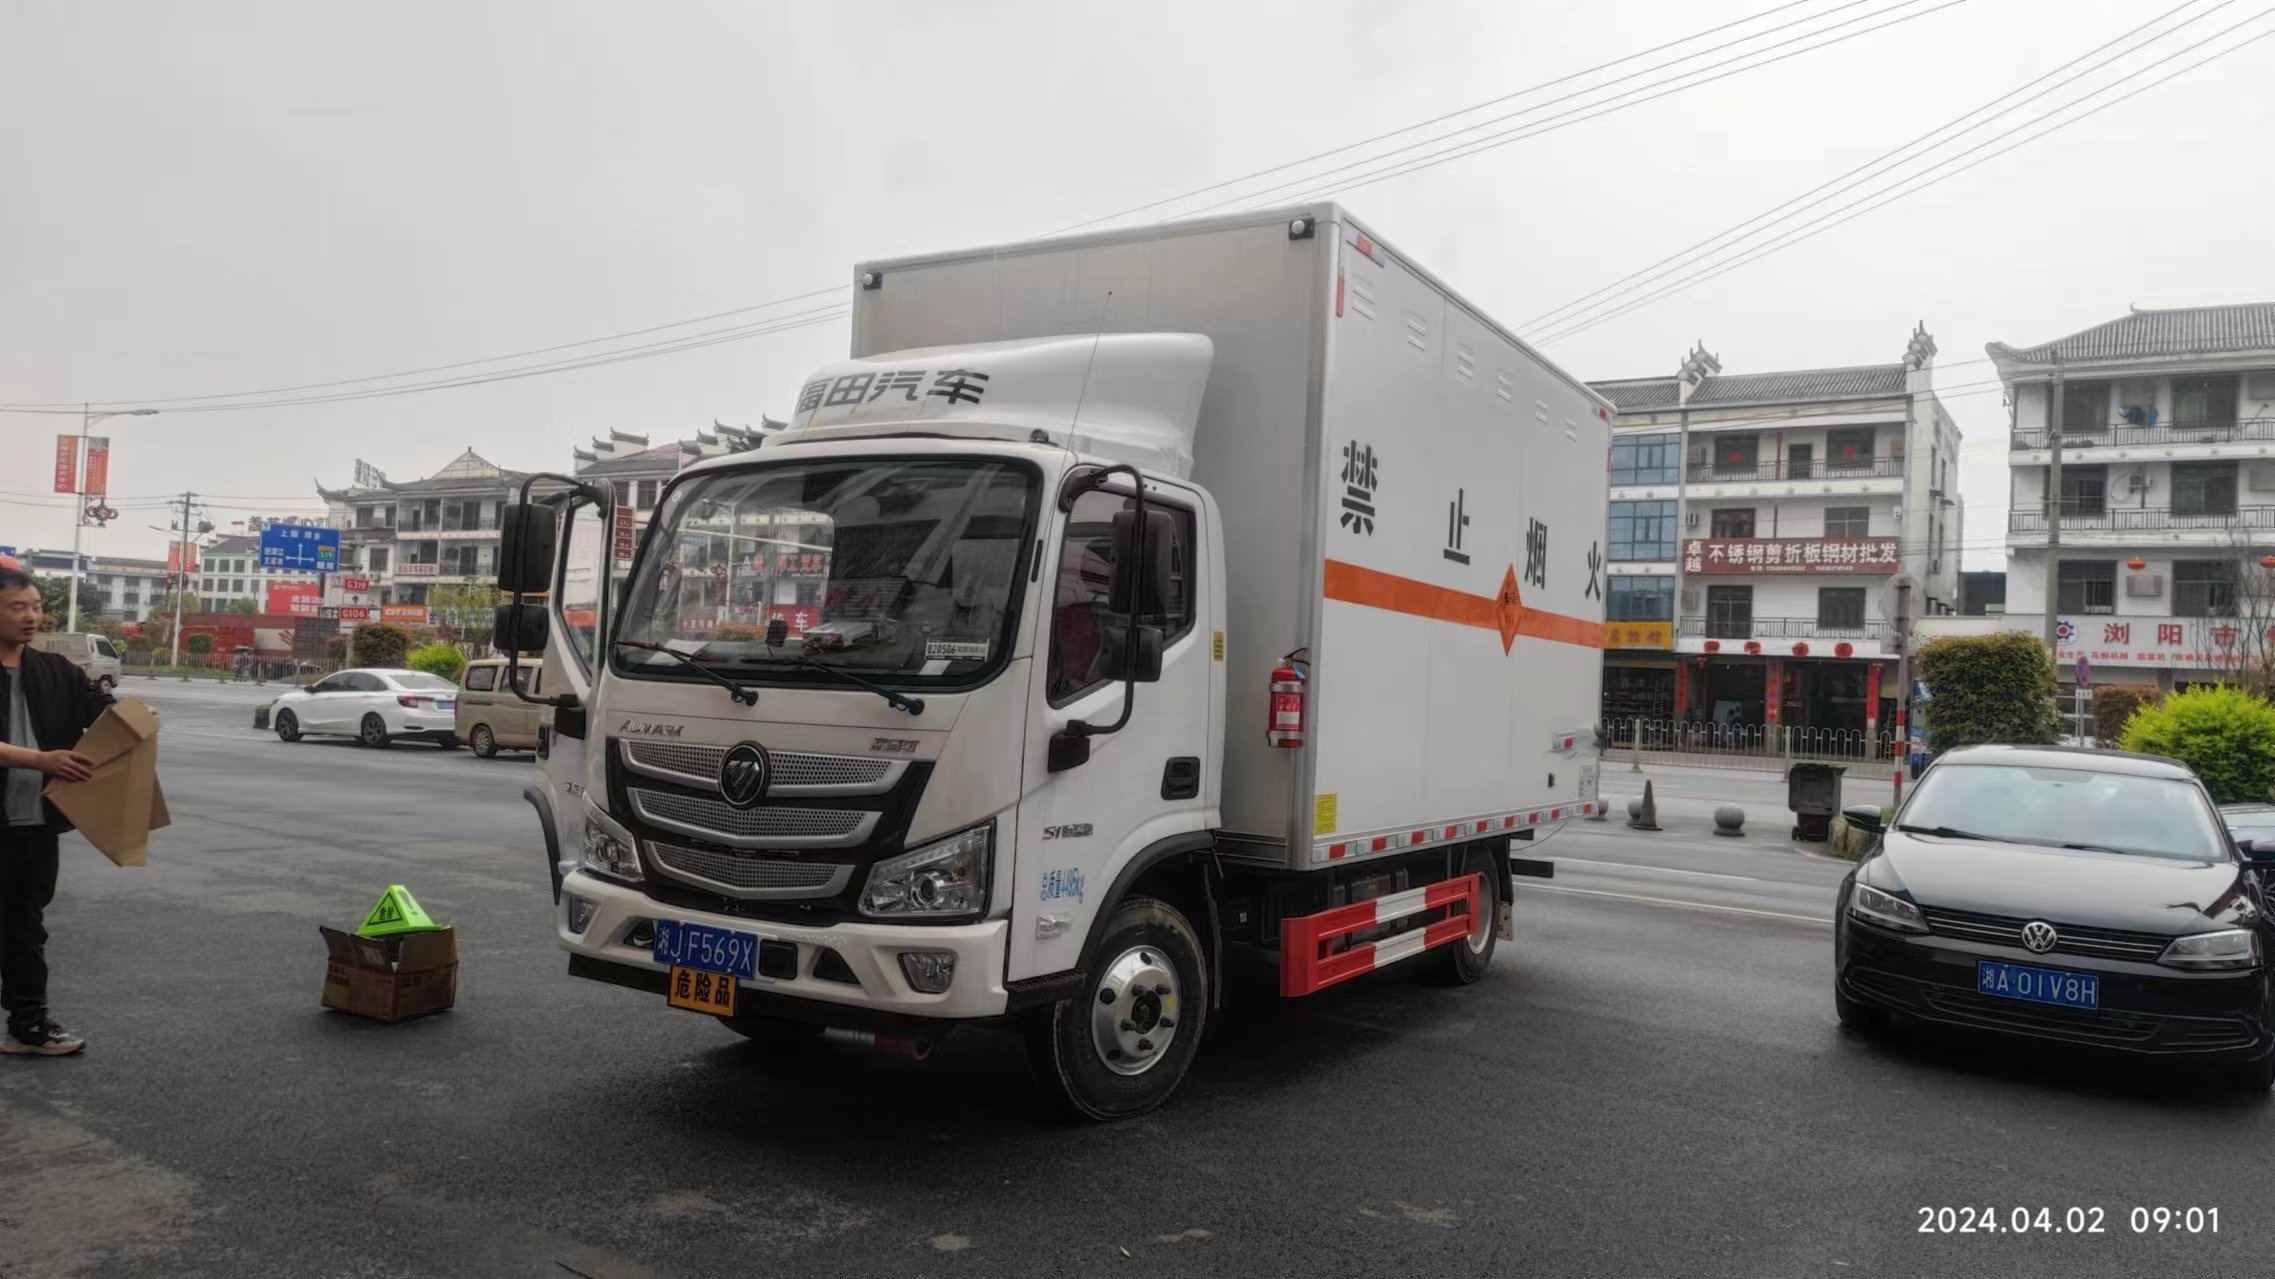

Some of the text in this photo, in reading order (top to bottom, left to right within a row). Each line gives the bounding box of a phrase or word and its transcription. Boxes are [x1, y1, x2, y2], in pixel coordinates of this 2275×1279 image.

[1340, 439, 1602, 603] 禁止烟火
[1684, 540, 1703, 572] 卓越
[347, 580, 366, 590] G319
[342, 609, 365, 618] G106
[675, 969, 730, 1008] 危险品
